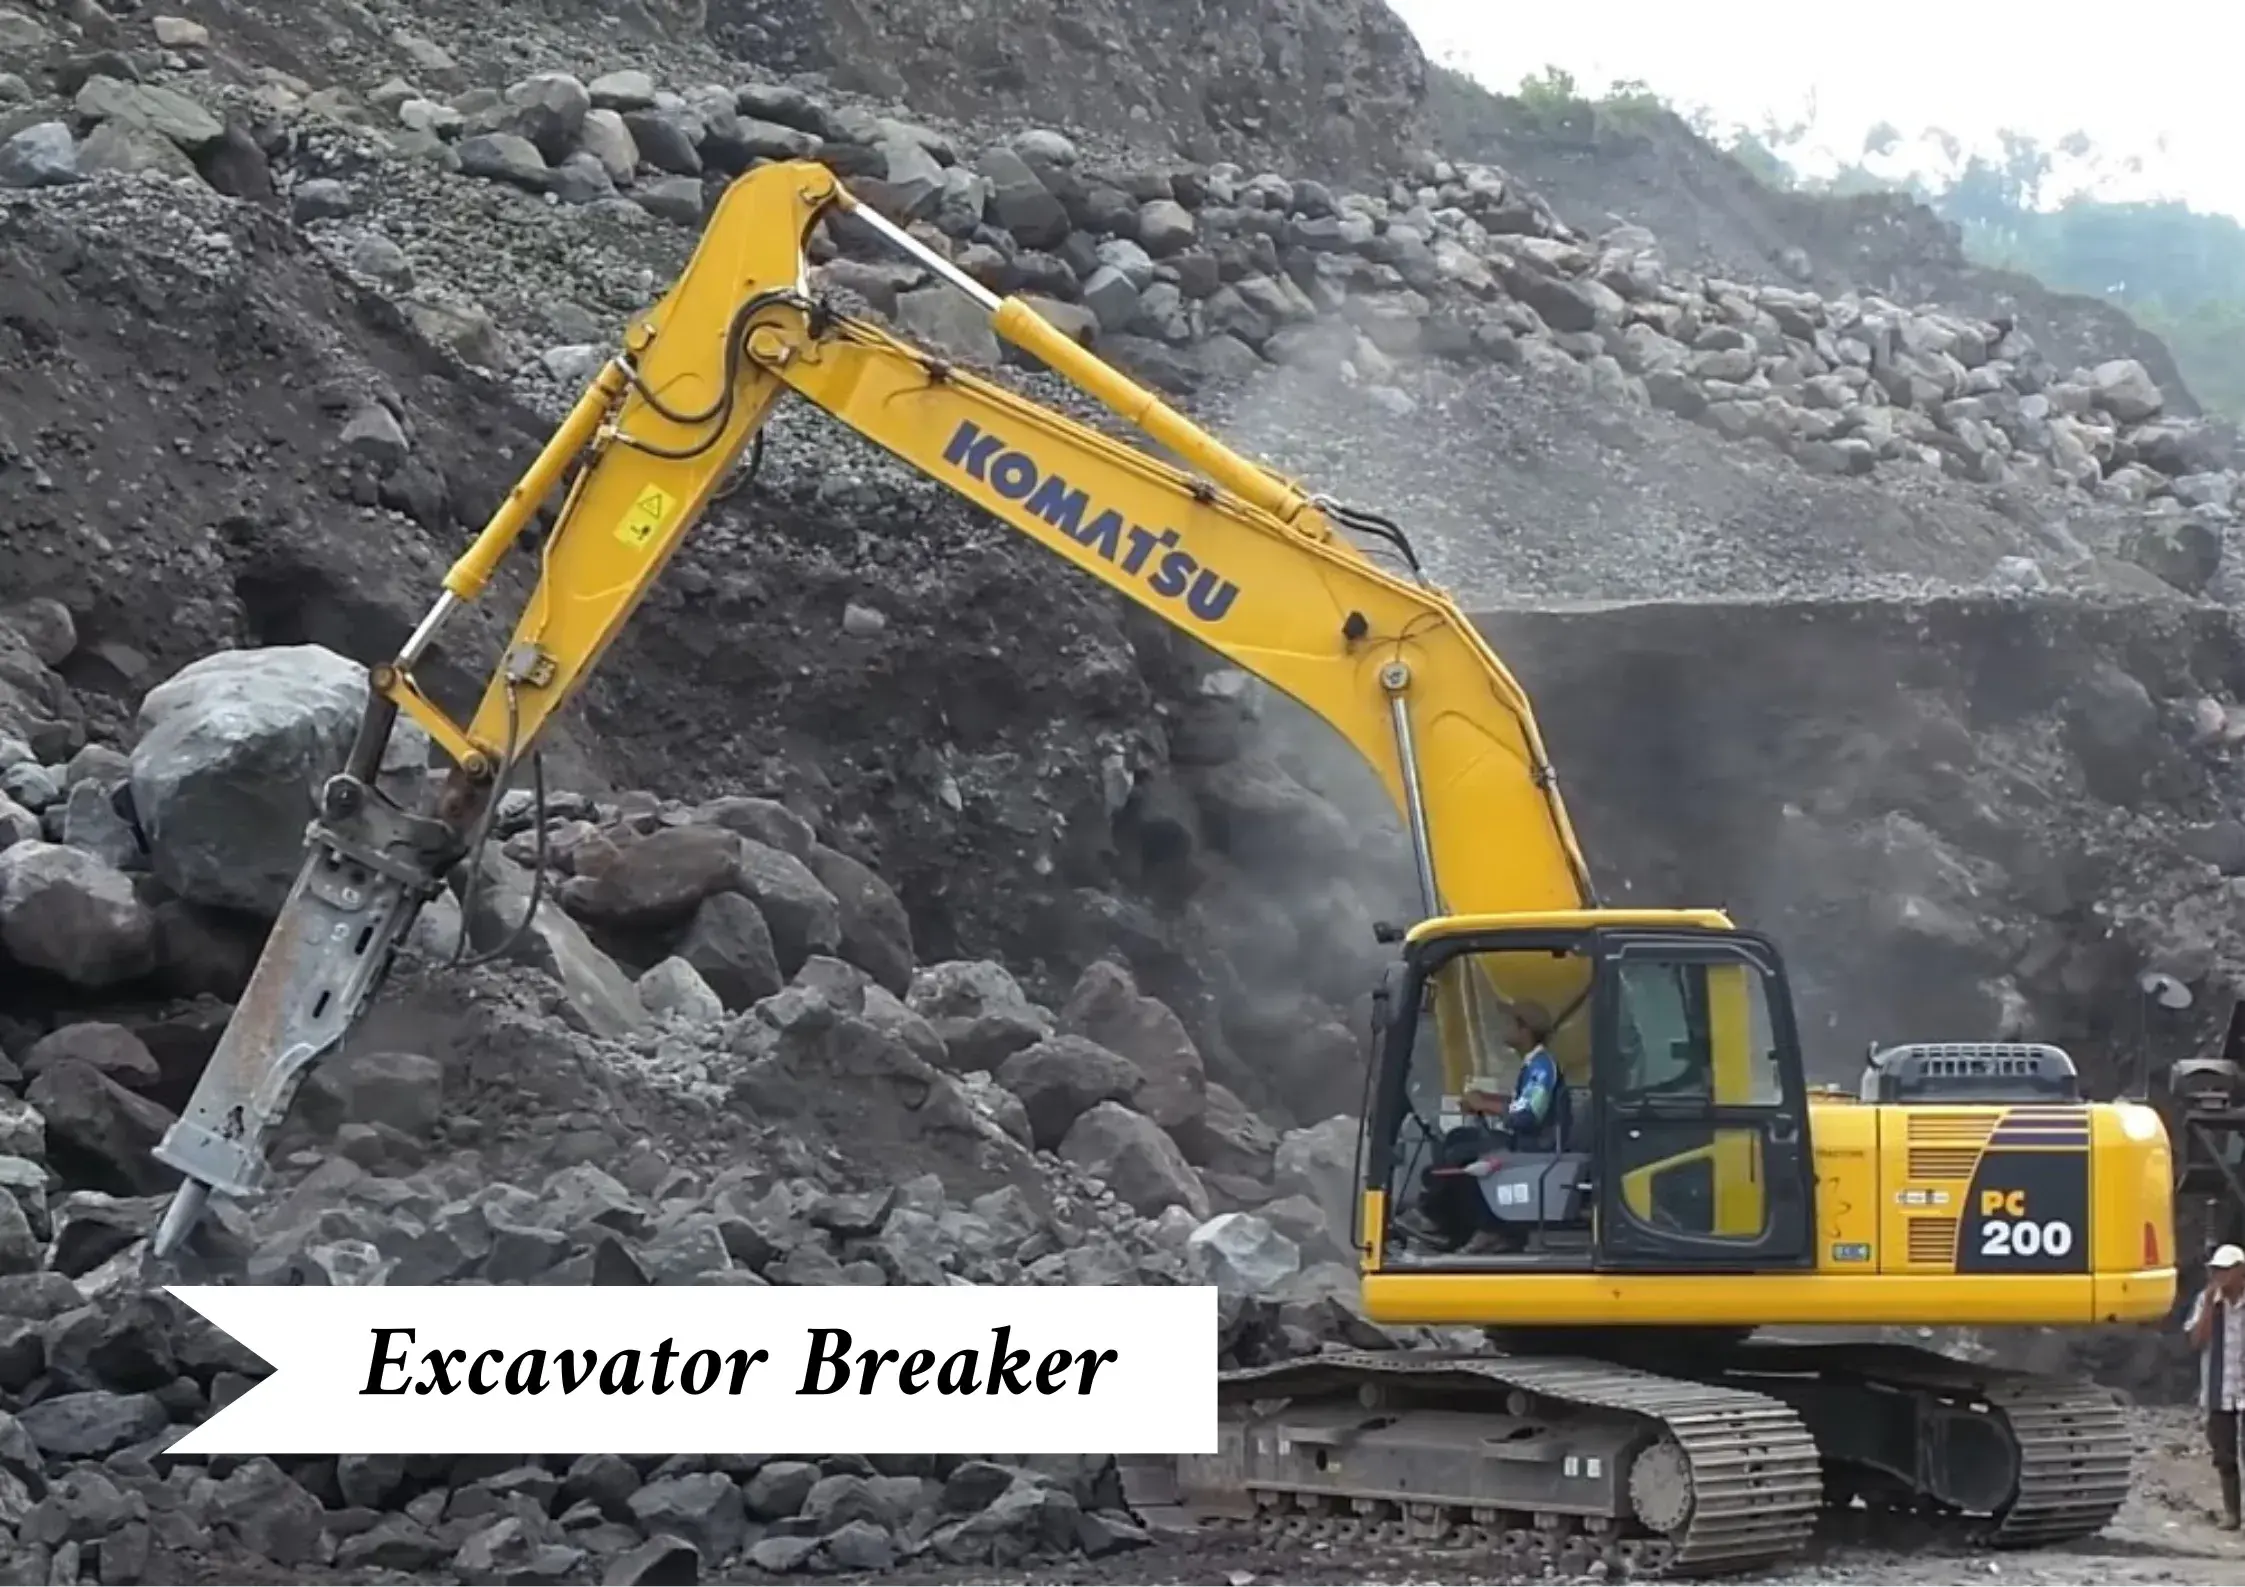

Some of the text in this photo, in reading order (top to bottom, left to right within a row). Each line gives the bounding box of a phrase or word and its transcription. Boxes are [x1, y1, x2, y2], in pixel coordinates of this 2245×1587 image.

[942, 419, 1240, 622] KOMATSU
[1981, 1190, 2025, 1216] PC
[1981, 1220, 2072, 1256] 200
